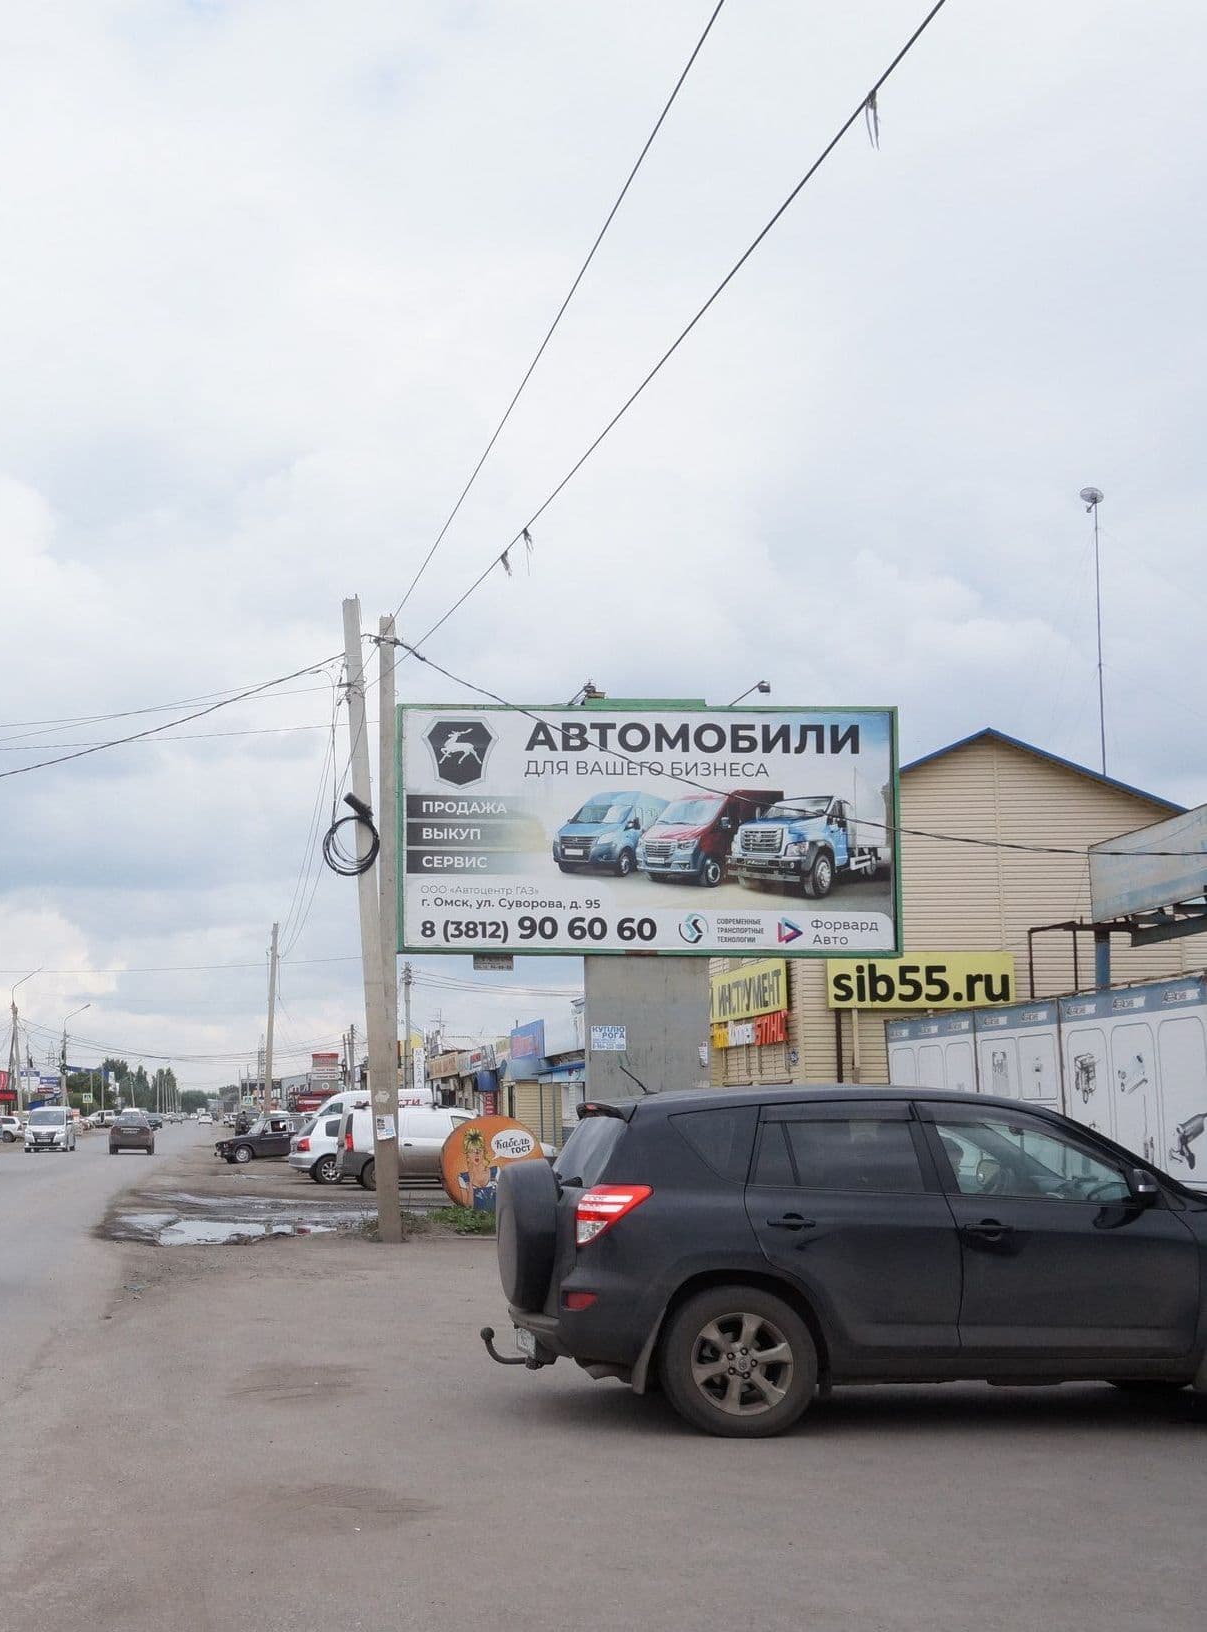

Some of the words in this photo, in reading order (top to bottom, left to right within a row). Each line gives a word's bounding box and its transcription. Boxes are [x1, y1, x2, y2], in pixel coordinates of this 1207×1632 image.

[524, 722, 860, 755] АВТОМОБИЛИ
[524, 760, 568, 778] ДЛЯ
[575, 760, 664, 777] ВАШЕГО
[670, 761, 769, 778] БИЗНЕСА
[422, 801, 508, 816] ПРОДАЖА
[422, 828, 481, 840] ВЫКУП
[422, 856, 488, 868] СЕРВИС
[420, 885, 448, 894] ООО
[421, 899, 430, 907] г.
[434, 897, 473, 909] Омск,
[476, 899, 495, 909] ул.
[498, 898, 566, 910] Суворова,
[569, 900, 582, 909] д.
[585, 899, 601, 909] 95
[716, 918, 762, 926] СОВРЕМЕННЫЕ
[810, 918, 879, 933] Форвард
[421, 920, 436, 938] 8
[442, 919, 509, 943] (3812)
[518, 916, 558, 940] 90
[567, 916, 608, 940] 60
[616, 917, 658, 941] 60
[716, 927, 765, 935] ТРАНСПОРТНЫЕ
[716, 936, 756, 944] ТЕХНОЛОГИИ
[811, 934, 849, 946] Авто
[832, 963, 1010, 1002] sib55.ru
[718, 968, 781, 1018] ИНСТРУМЕНТ
[494, 1137, 530, 1150] Кабель
[511, 1144, 531, 1154] ГОСТ
